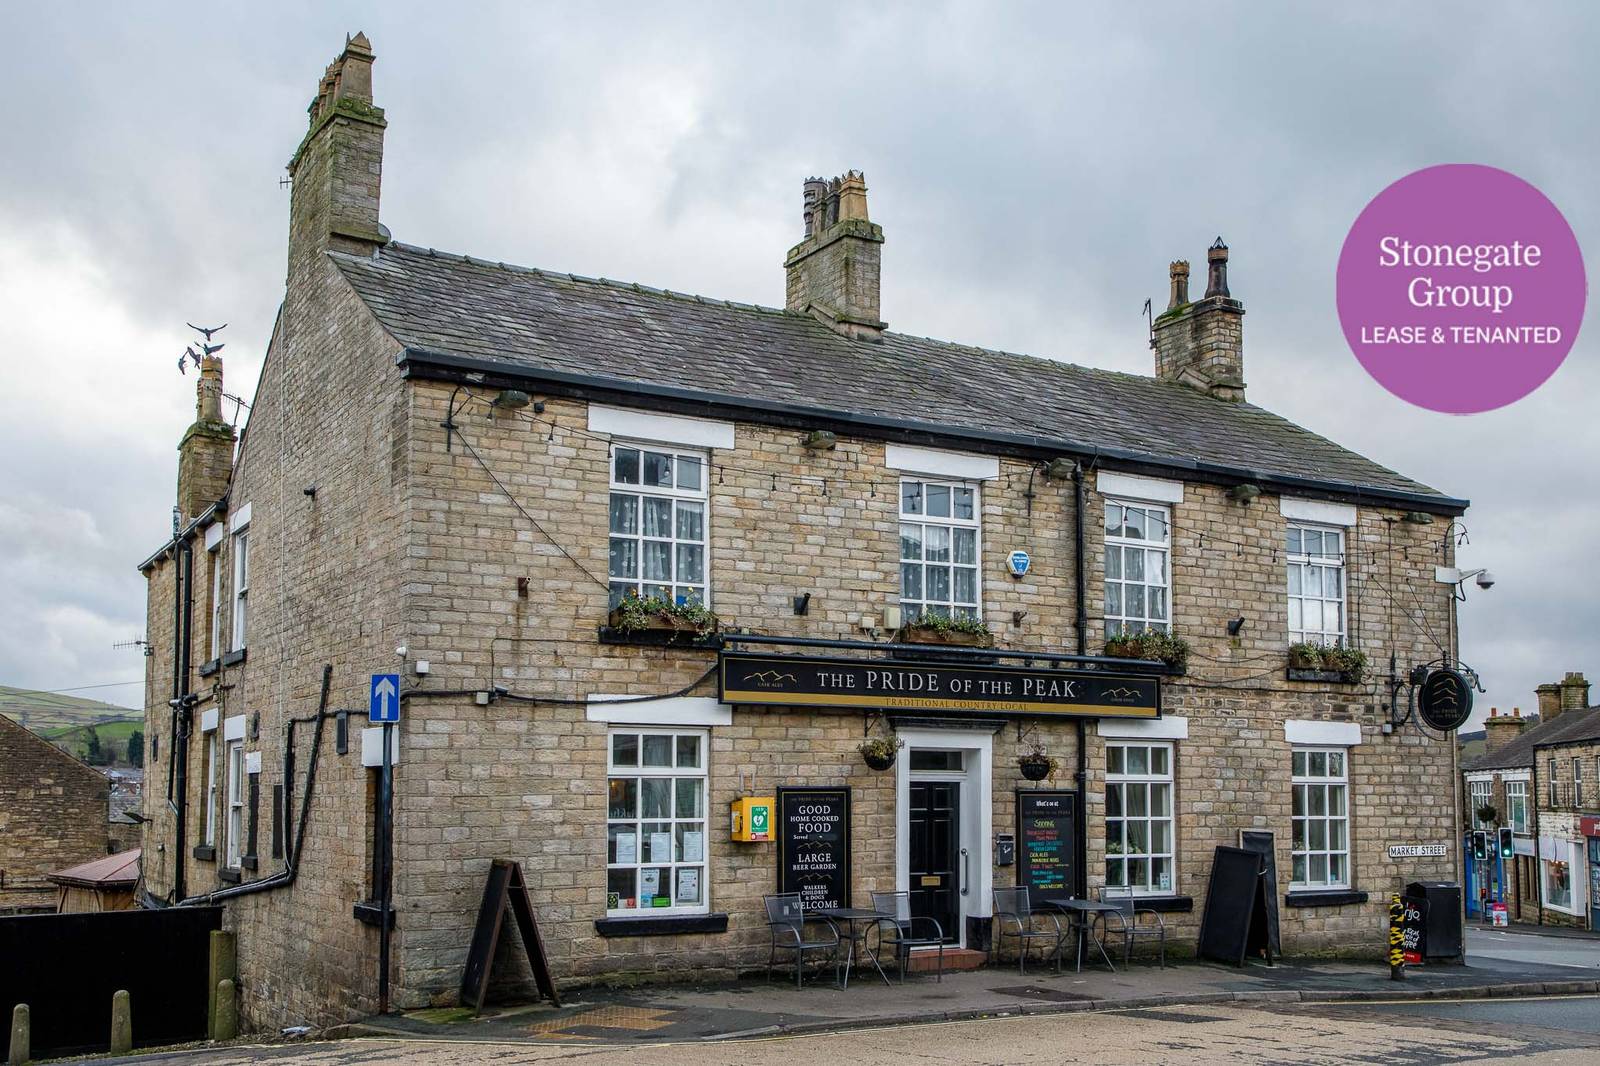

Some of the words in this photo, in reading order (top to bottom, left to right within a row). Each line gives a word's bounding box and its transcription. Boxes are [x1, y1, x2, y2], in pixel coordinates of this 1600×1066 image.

[817, 672, 856, 689] THE
[866, 670, 940, 692] PRIDE
[950, 679, 972, 693] OF
[979, 680, 1013, 695] THE
[1022, 678, 1076, 698] PEAK
[885, 698, 949, 708] TRADITIONAL
[953, 702, 998, 710] COUNTRY
[798, 805, 831, 814] GOOD
[798, 823, 831, 832] FOOD
[1390, 846, 1418, 856] MARKET
[1421, 845, 1445, 855] STREET
[798, 853, 832, 863] LARGE
[792, 900, 838, 909] WELCOME
